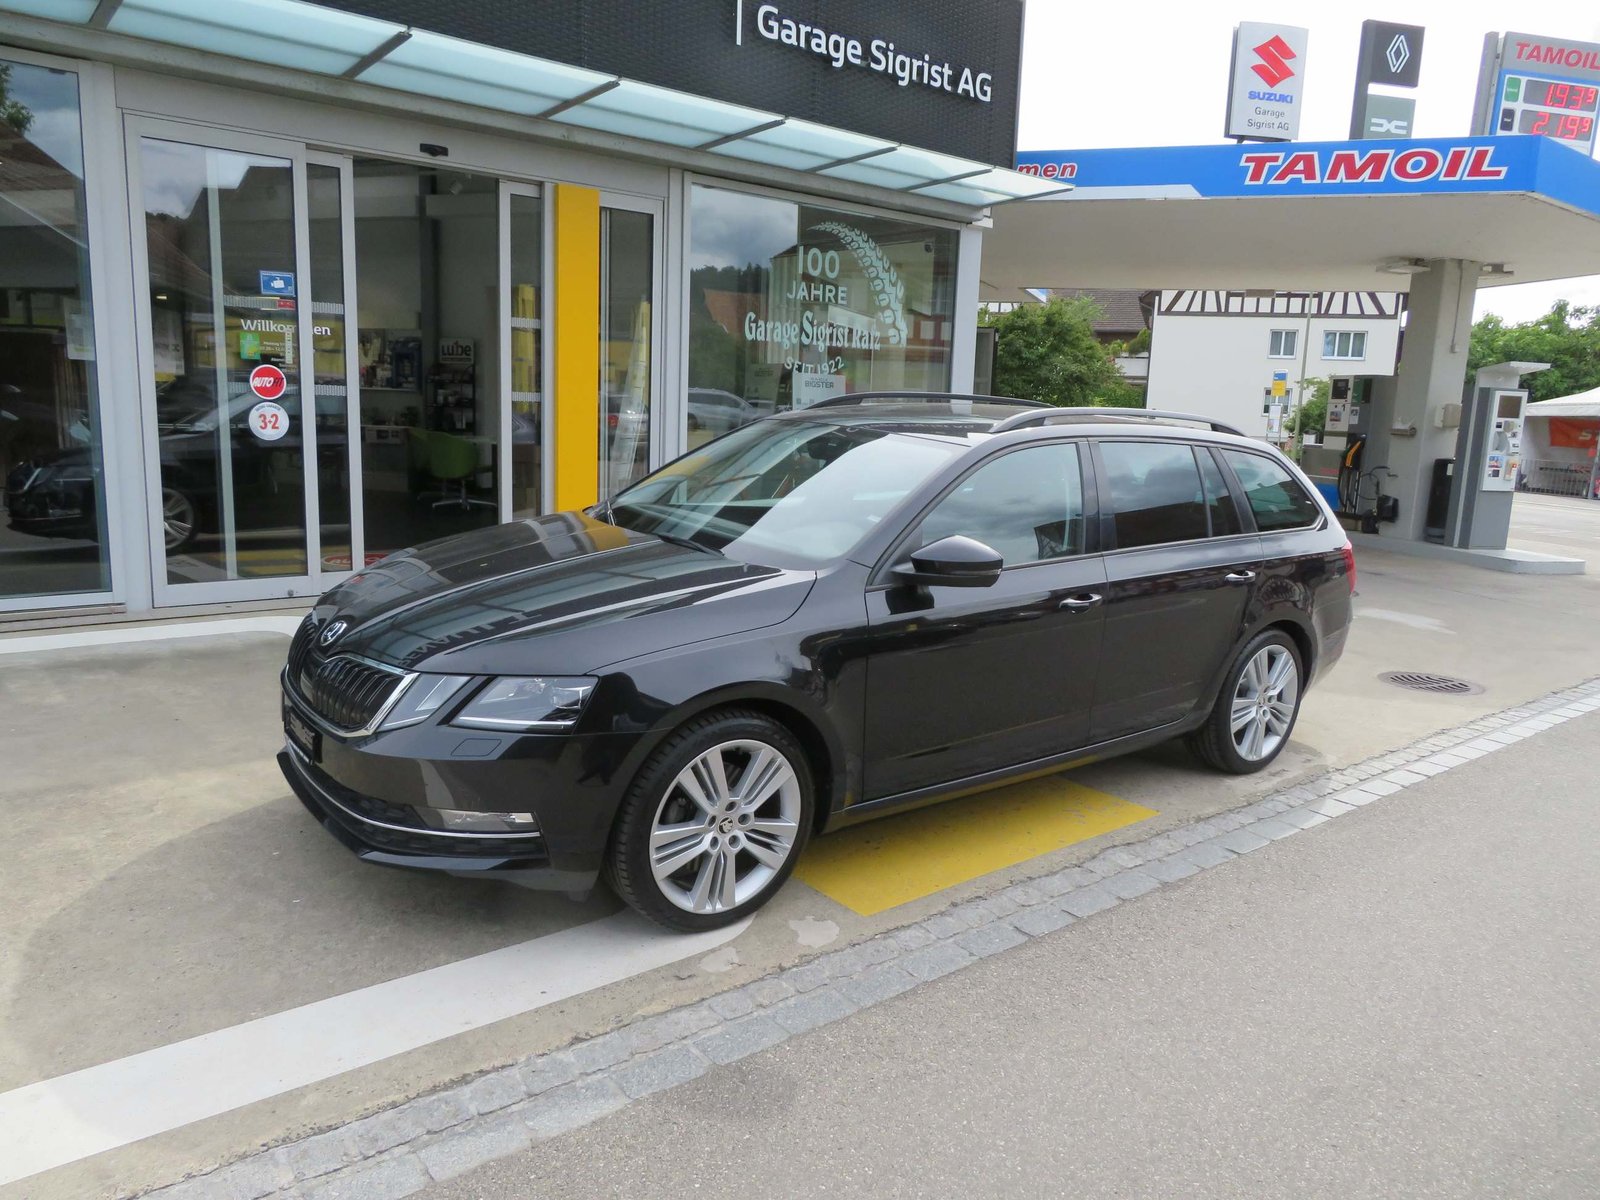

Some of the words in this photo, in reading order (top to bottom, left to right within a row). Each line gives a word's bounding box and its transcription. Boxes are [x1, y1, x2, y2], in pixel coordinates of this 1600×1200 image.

[757, 5, 863, 68] Garage
[870, 39, 953, 92] Sigrist
[957, 67, 993, 103] AG
[1515, 41, 1600, 71] TAMOIL
[1248, 91, 1293, 105] SUZUKI
[1247, 118, 1275, 130] Sigrist
[1277, 121, 1290, 131] AG
[1255, 106, 1285, 119] Garage
[1240, 145, 1508, 186] TAMOIL
[798, 246, 840, 279] 100
[787, 279, 848, 305] JAHRE
[744, 311, 799, 350] Garage
[801, 310, 850, 352] Sigrist
[784, 356, 816, 374] SEIT
[817, 356, 845, 375] 1922
